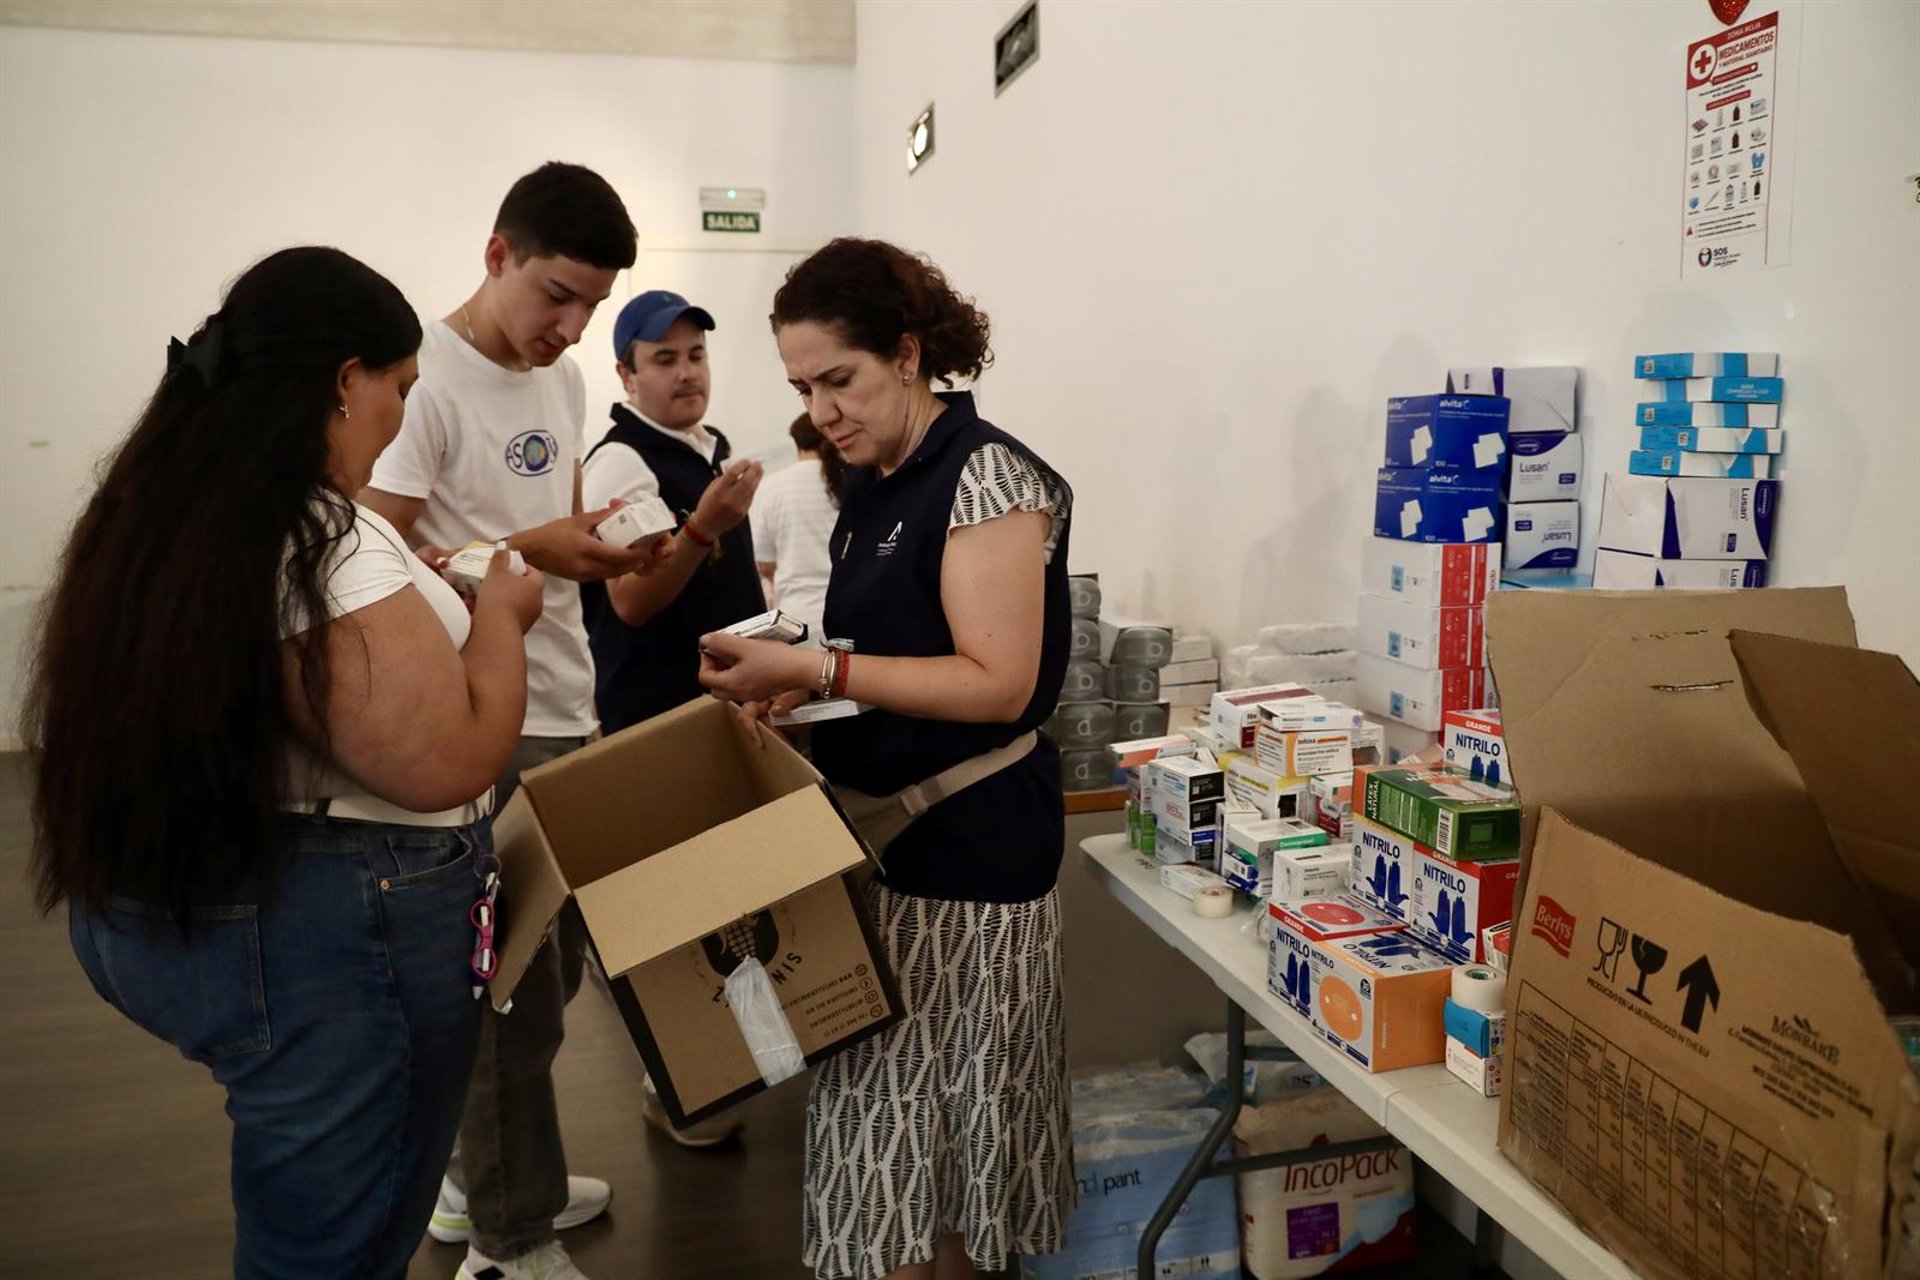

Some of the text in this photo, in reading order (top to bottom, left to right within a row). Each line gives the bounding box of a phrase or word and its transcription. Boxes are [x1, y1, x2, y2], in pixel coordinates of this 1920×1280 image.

[1719, 30, 1775, 60] MEDICAMENTOS
[707, 214, 756, 231] SALIDA
[1713, 247, 1728, 257] SOS
[1440, 400, 1463, 409] alvita
[1429, 474, 1452, 483] alvita
[1519, 462, 1549, 473] Lusan
[1740, 487, 1750, 519] Lusan
[1543, 532, 1572, 542] Lusan
[1730, 568, 1740, 587] Lus
[1465, 720, 1492, 733] GRANDE
[1456, 732, 1501, 757] NITRILO
[1372, 779, 1380, 820] NATURAL
[1362, 831, 1401, 859] NITRILO
[1423, 862, 1466, 894] NITRILO
[1536, 904, 1573, 940] Berlys
[1276, 927, 1310, 958] NITRILO
[1311, 948, 1335, 969] NITRILO
[1103, 1169, 1143, 1197] pant
[1284, 1148, 1400, 1193] IncoPack
